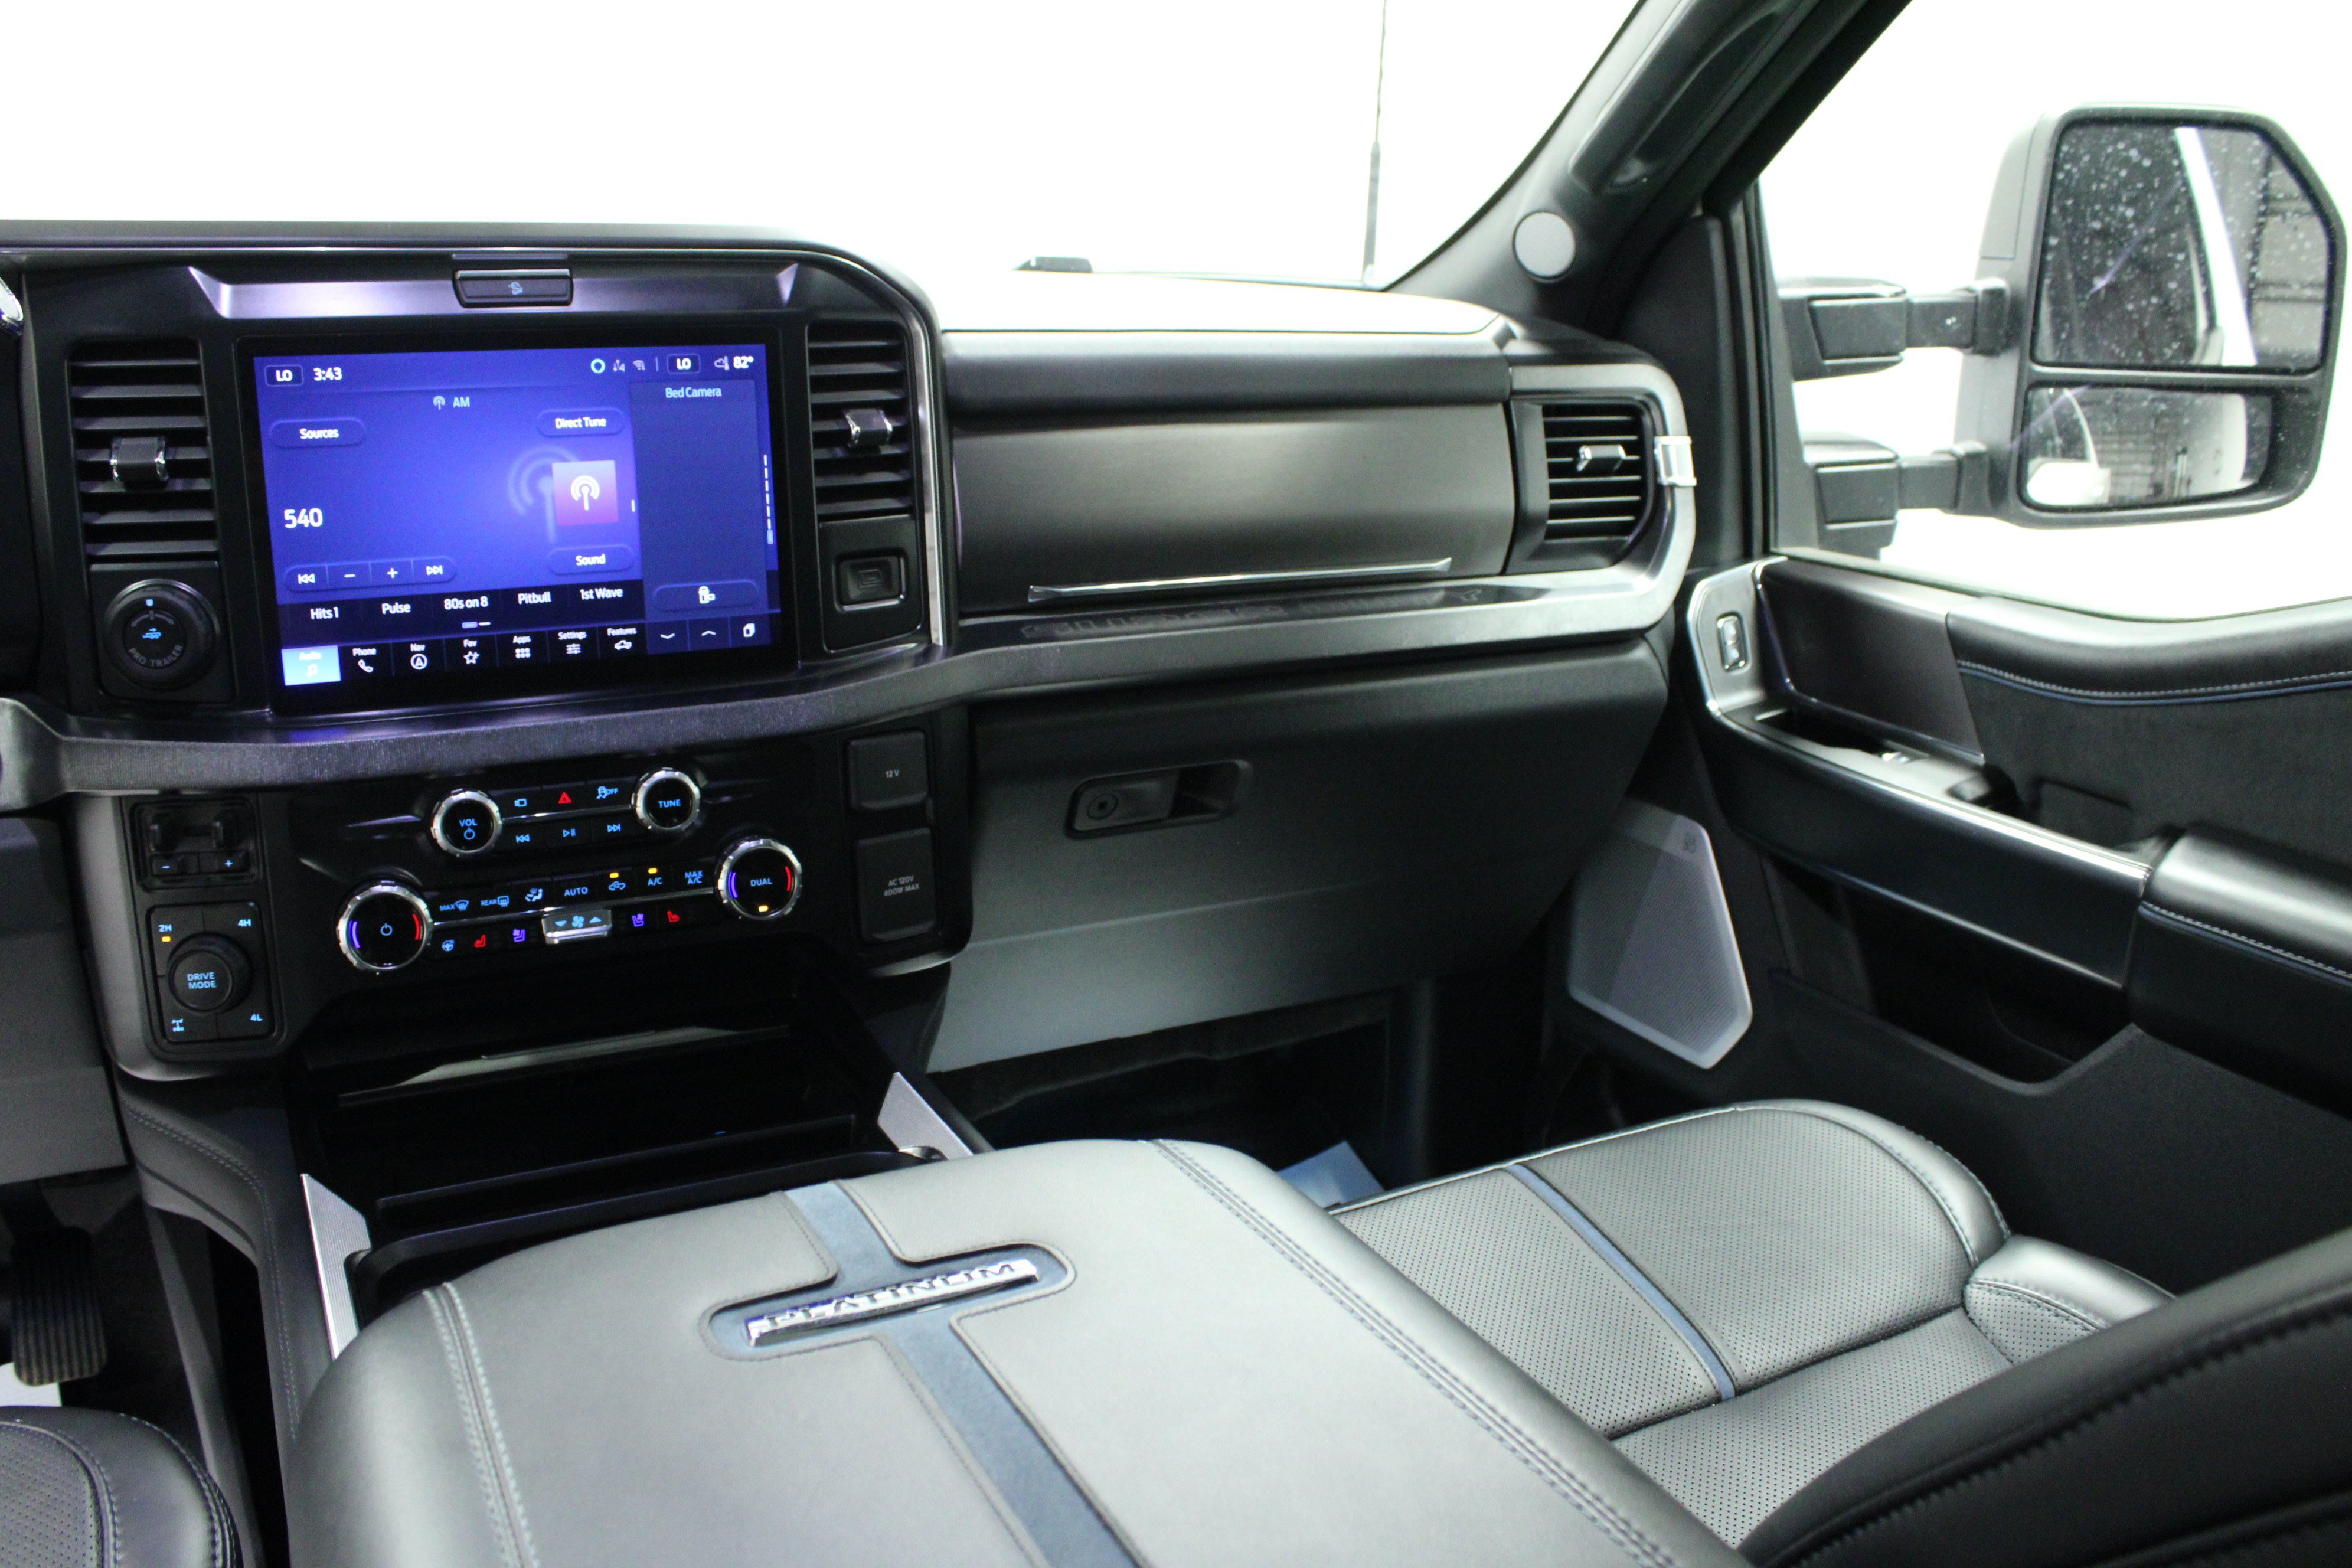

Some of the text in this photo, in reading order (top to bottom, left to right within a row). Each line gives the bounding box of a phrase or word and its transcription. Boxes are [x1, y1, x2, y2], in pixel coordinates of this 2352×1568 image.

[676, 357, 692, 370] LO
[275, 368, 293, 382] LO
[313, 367, 343, 381] 3:43
[665, 387, 722, 398] Bed Camera
[452, 396, 471, 408] AM
[555, 416, 607, 429] Direct Tune
[299, 427, 339, 440] Sources
[283, 507, 324, 529] 540
[576, 553, 606, 566] Sound
[518, 592, 552, 605] Pitbull
[580, 587, 623, 600] 1st Wave
[443, 596, 489, 610] 80s on 8
[310, 606, 339, 619] Hits 1
[381, 602, 411, 615] Pulse
[558, 631, 587, 641] Settings
[607, 626, 637, 636] Features
[463, 639, 478, 648] Fav
[512, 635, 531, 645] Apps
[352, 646, 377, 656] Phone
[410, 643, 426, 652] Nav
[129, 644, 183, 666] PRO TRAILER
[299, 651, 322, 661] Audio
[658, 799, 681, 808] TUNE
[459, 818, 478, 827] VOL
[648, 877, 663, 886] A/C
[687, 876, 703, 884] A/C
[750, 877, 773, 886] DUAL
[564, 887, 589, 896] AUTO
[904, 883, 920, 891] MAX
[159, 924, 172, 932] 2H
[237, 919, 251, 927] 4H
[187, 971, 215, 981] DRIVE
[188, 979, 217, 989] MODE
[250, 1013, 263, 1021] 4L
[760, 1261, 1018, 1328] PLATINUM
